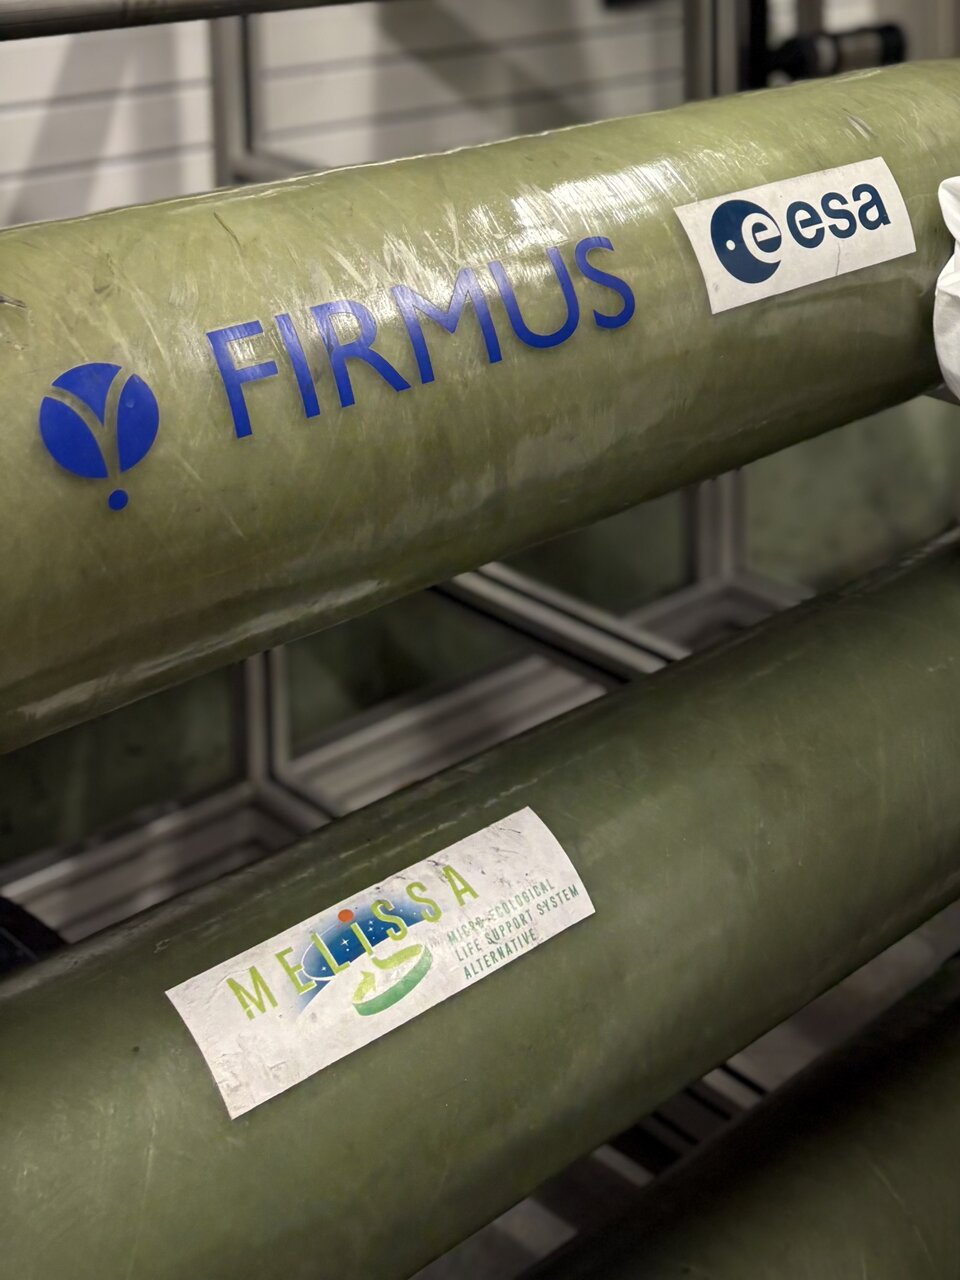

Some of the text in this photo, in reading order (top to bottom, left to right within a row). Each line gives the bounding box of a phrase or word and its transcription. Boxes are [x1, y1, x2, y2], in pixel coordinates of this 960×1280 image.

[786, 183, 892, 249] esa
[206, 236, 636, 439] FIRMUS
[455, 884, 580, 962] LIFE SUPPORT SYSTEM
[463, 927, 538, 980] ALTERNATIVE
